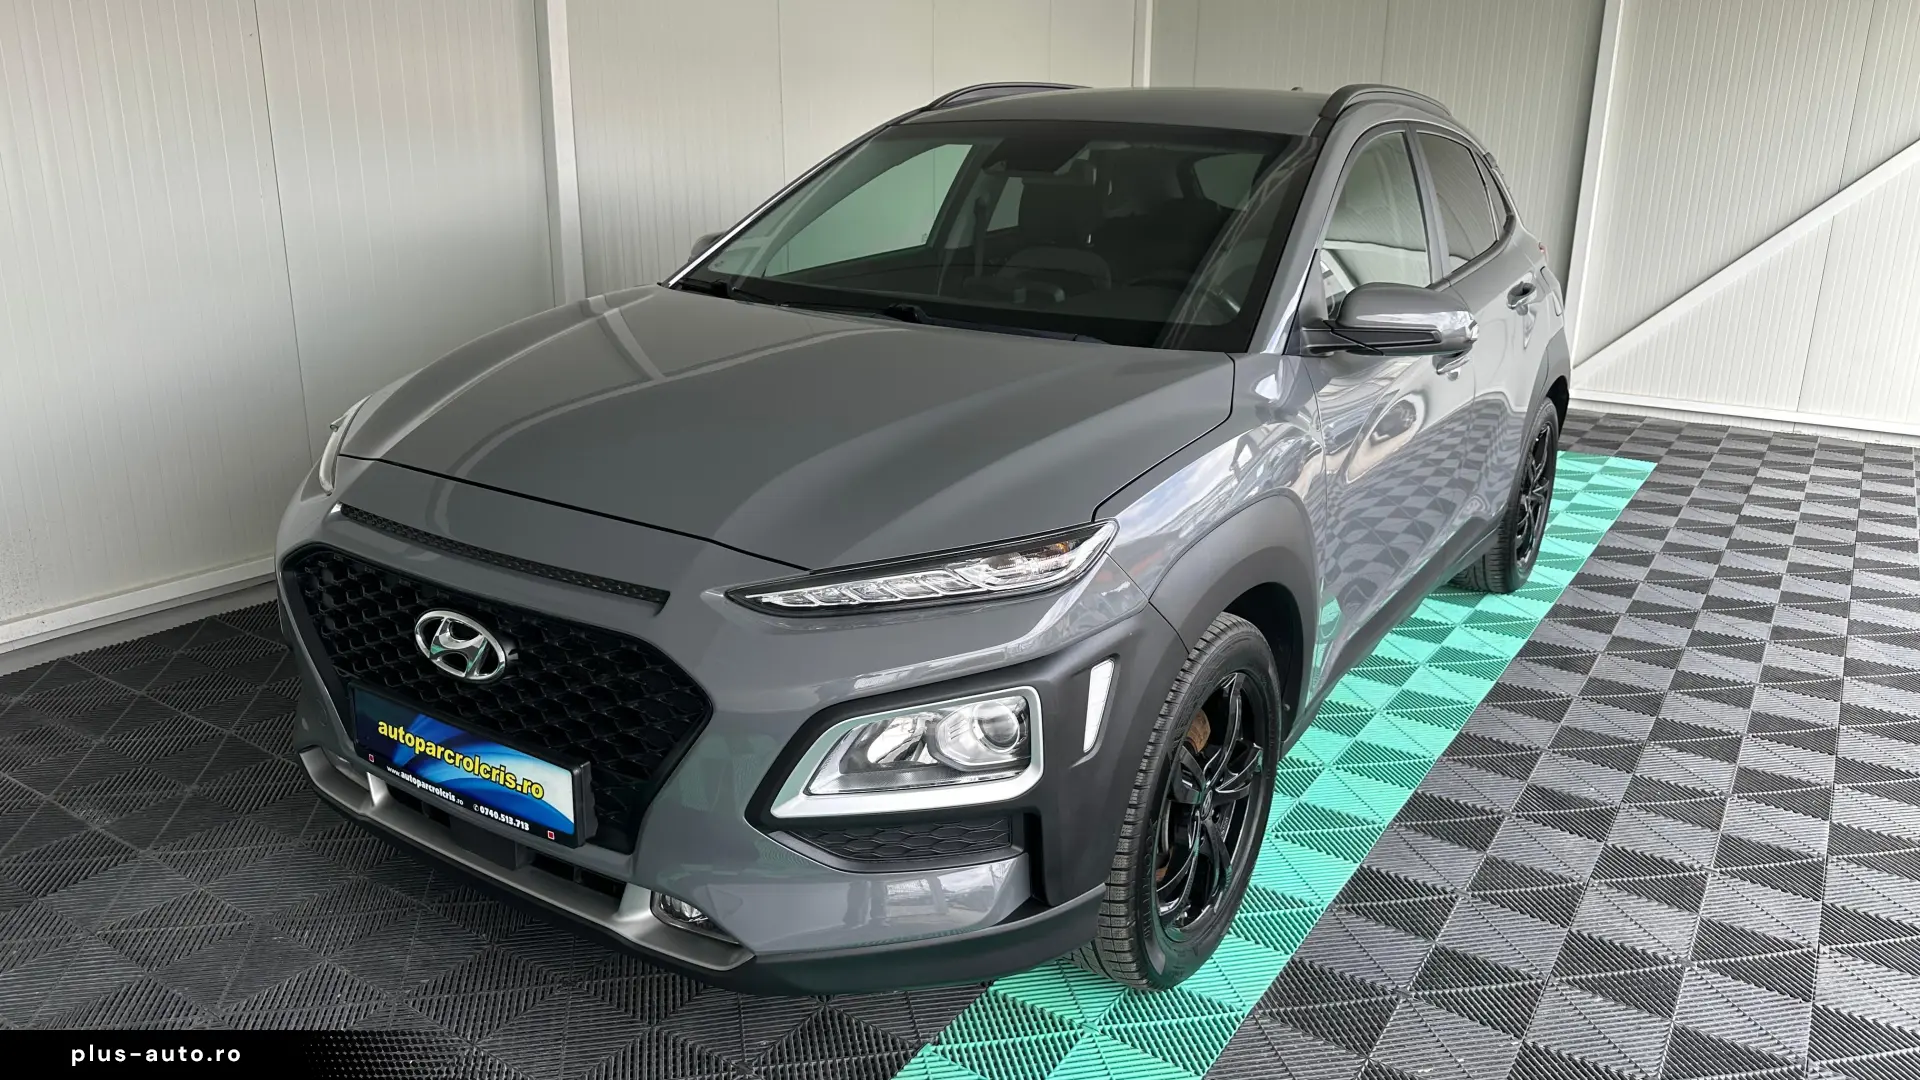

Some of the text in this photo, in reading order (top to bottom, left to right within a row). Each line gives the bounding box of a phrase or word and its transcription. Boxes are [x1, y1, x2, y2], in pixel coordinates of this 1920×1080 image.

[377, 720, 545, 799] autoparcrolcris.ro
[386, 765, 464, 806] www.autoparcrolcris.ro
[479, 805, 530, 831] 0740.513.713
